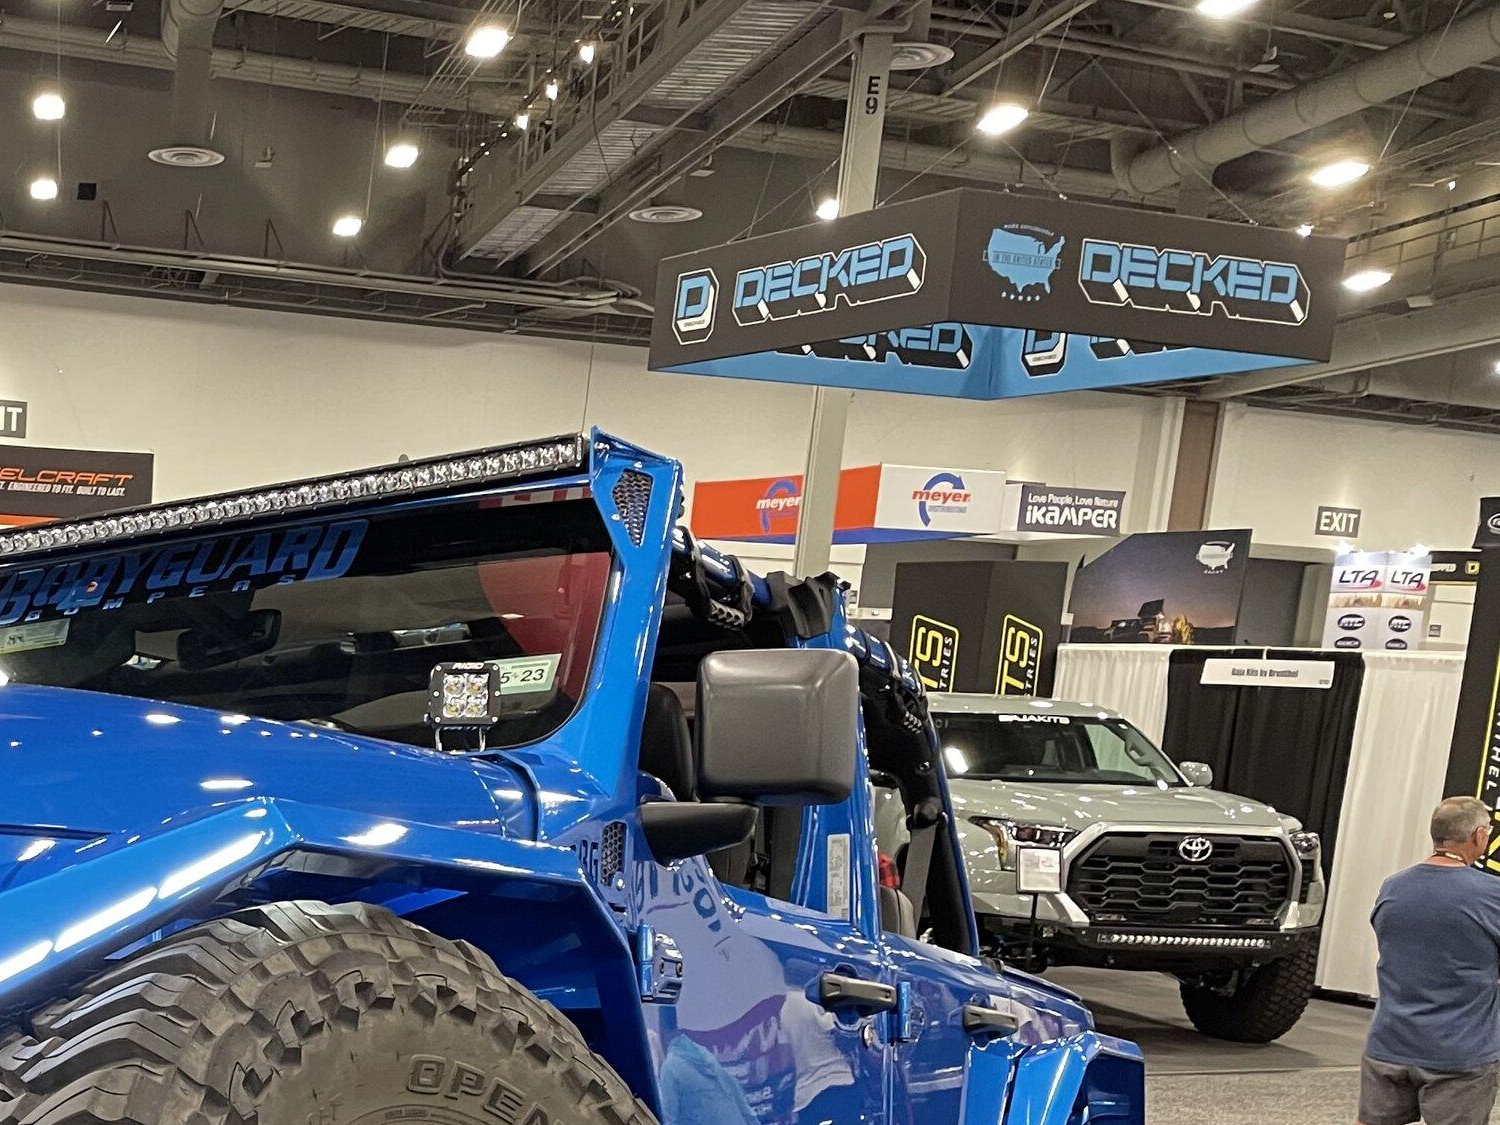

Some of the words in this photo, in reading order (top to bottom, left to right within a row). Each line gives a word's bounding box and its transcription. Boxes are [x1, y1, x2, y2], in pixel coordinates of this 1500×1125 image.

[734, 235, 920, 316] DECKED
[1081, 240, 1304, 316] DECKED
[7, 481, 51, 493] ENGINEERED
[51, 483, 62, 494] TO
[76, 485, 97, 496] BUILT
[97, 486, 107, 496] TO
[756, 495, 802, 511] meyer
[912, 489, 972, 505] meyer
[1028, 492, 1047, 504] Love
[1075, 495, 1093, 506] Love
[1319, 511, 1359, 533] EXIT
[1338, 570, 1379, 586] LTA
[1390, 570, 1424, 588] LTA
[24, 574, 296, 623] BUMPERS
[998, 713, 1071, 726] BAJAKITS
